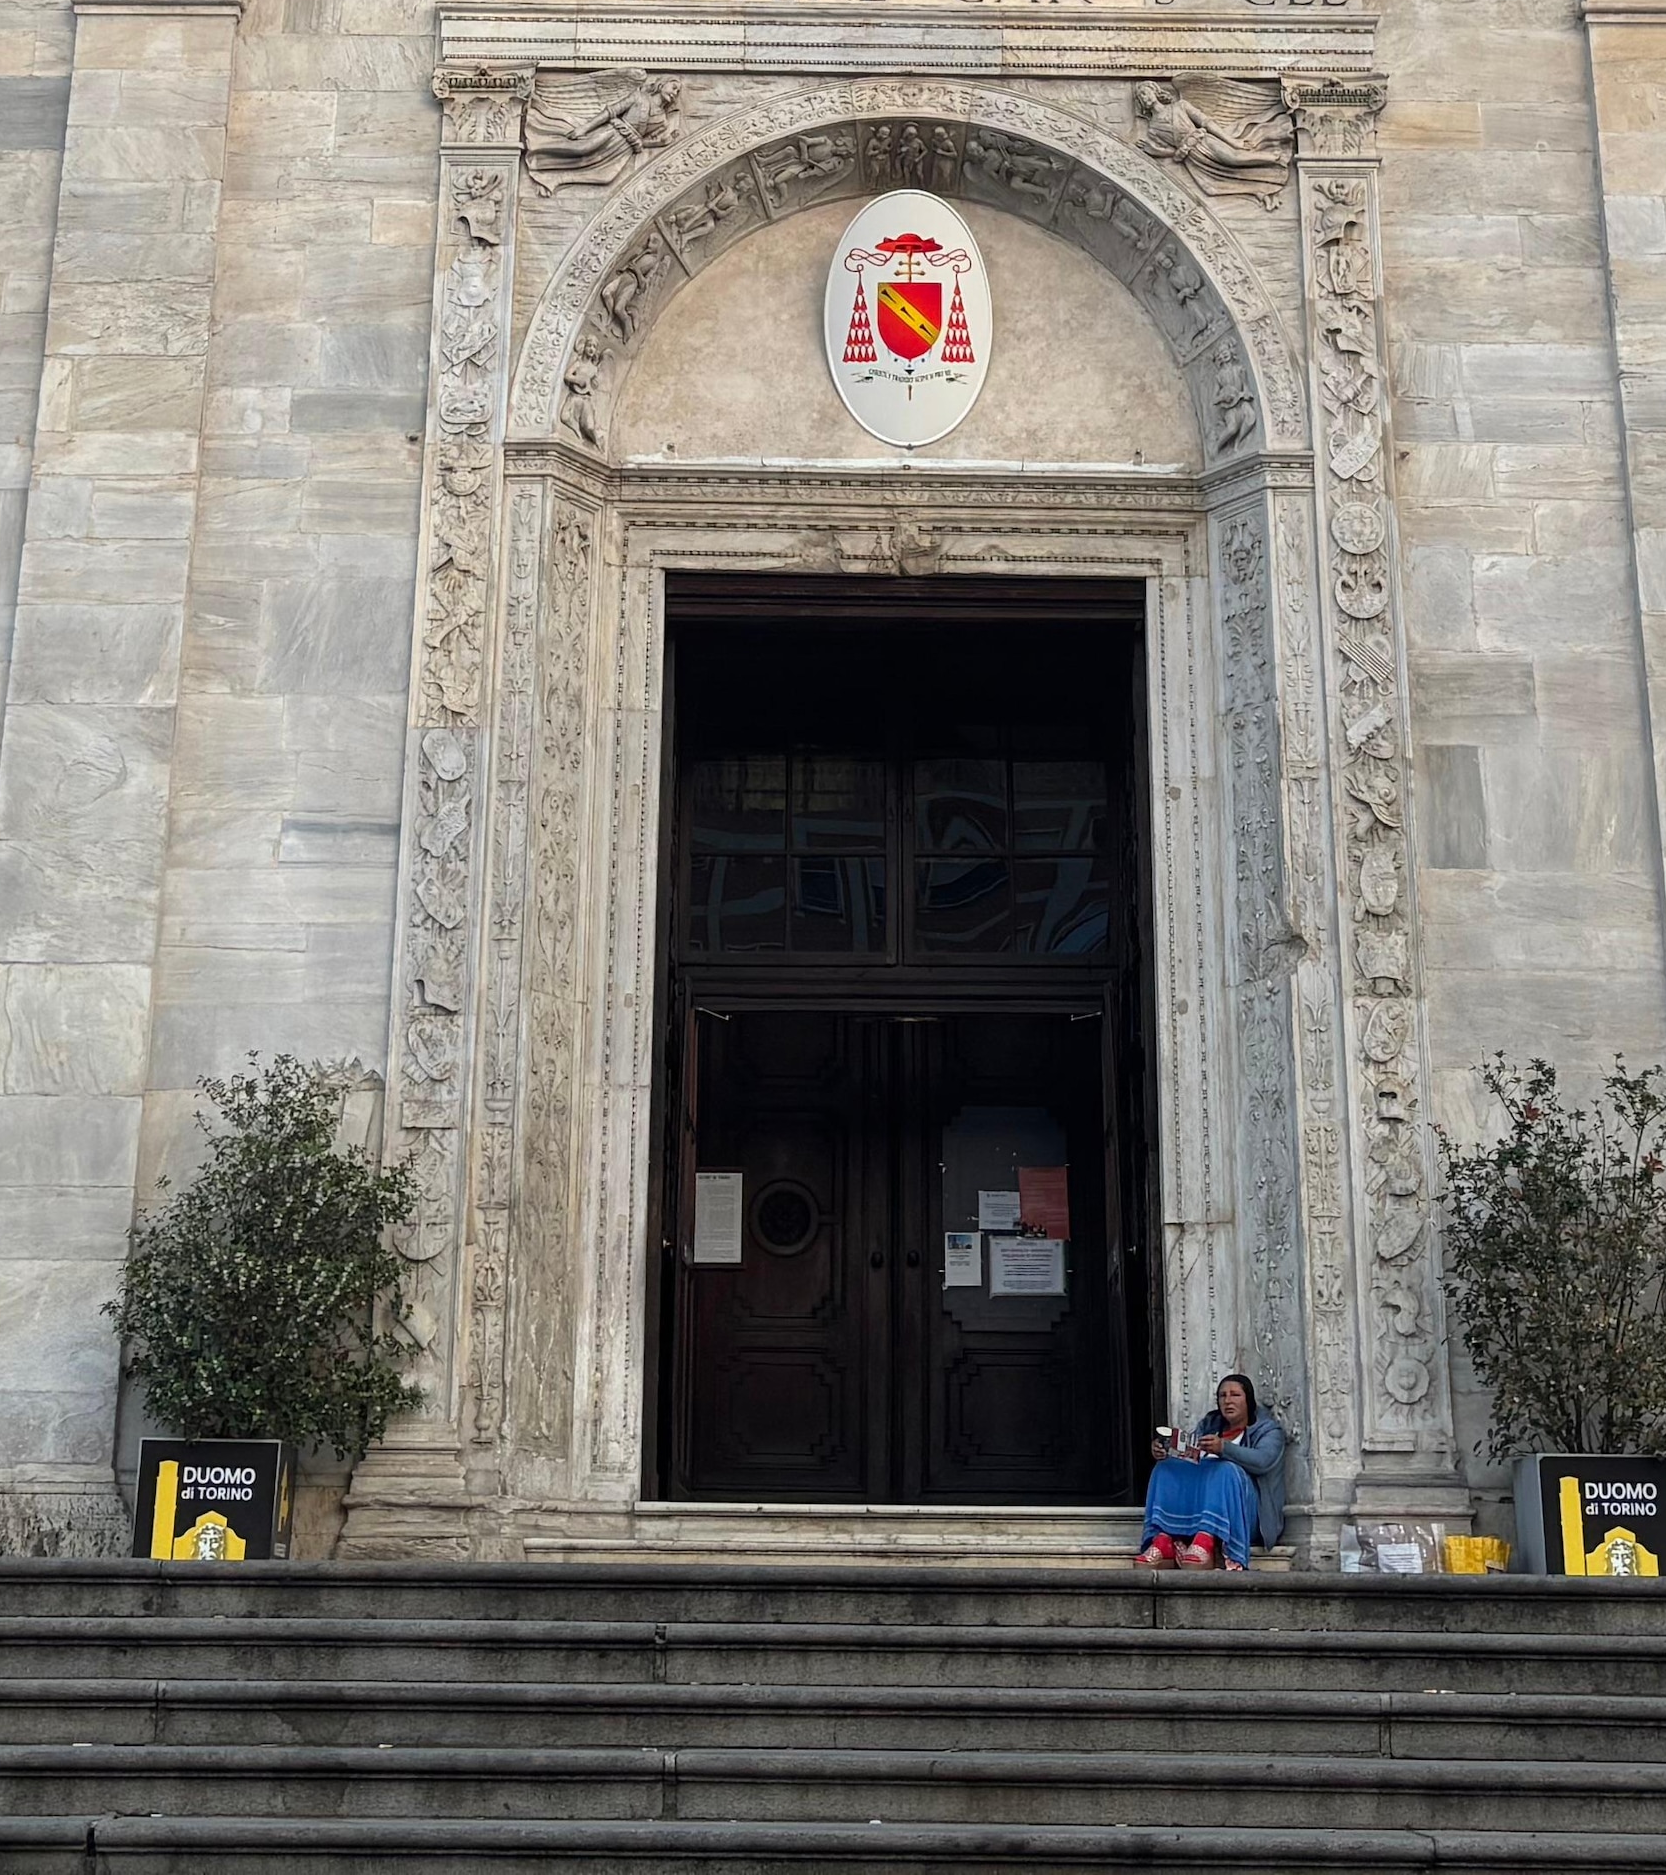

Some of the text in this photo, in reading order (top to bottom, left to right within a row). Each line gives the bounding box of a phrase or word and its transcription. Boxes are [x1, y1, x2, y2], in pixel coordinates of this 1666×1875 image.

[183, 1467, 256, 1485] DUOMO
[181, 1487, 252, 1501] di TORINO
[1585, 1483, 1657, 1500] DUOMO
[1586, 1503, 1656, 1516] di TORINO
